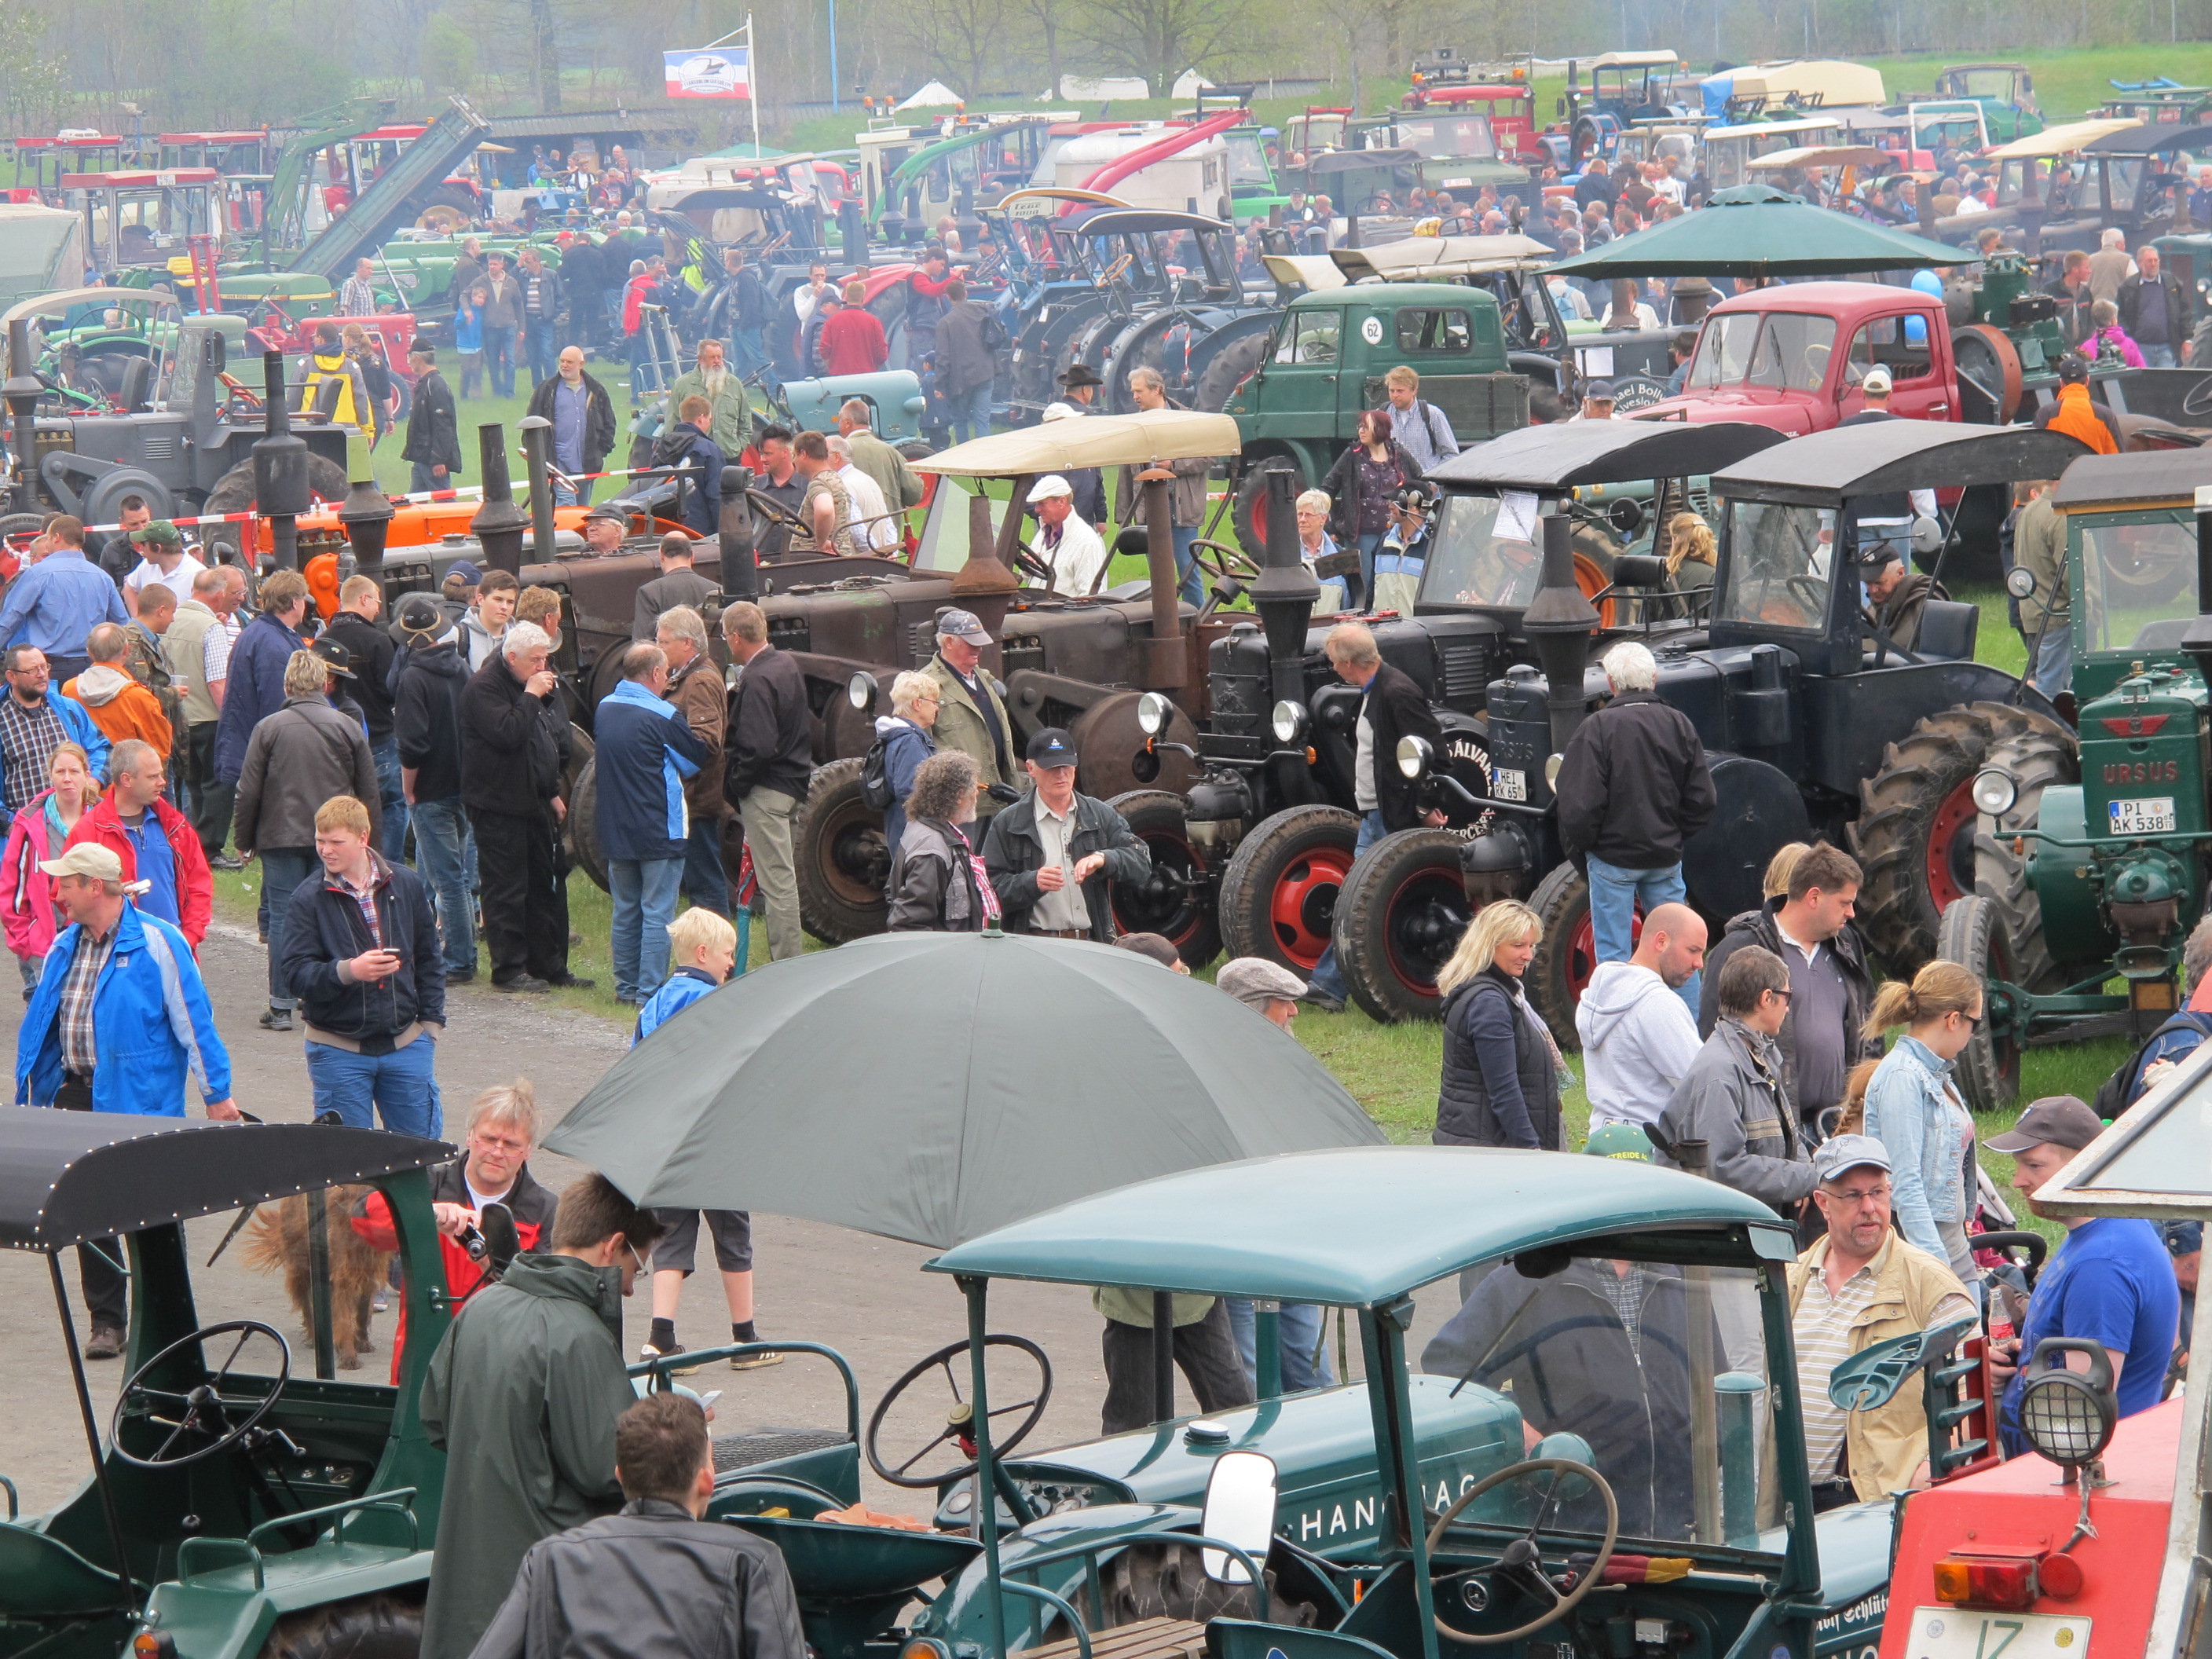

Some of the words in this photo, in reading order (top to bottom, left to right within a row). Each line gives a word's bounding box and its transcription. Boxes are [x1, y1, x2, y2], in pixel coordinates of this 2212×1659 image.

[1367, 323, 1379, 337] 62
[1500, 771, 1516, 785] HEI
[2104, 760, 2178, 785] URSUS
[1495, 783, 1504, 797] RK
[1507, 788, 1518, 799] 65
[2124, 803, 2142, 816] PI
[2113, 819, 2131, 833] AK
[2137, 815, 2164, 831] 538
[1301, 1474, 1476, 1542] HANAG
